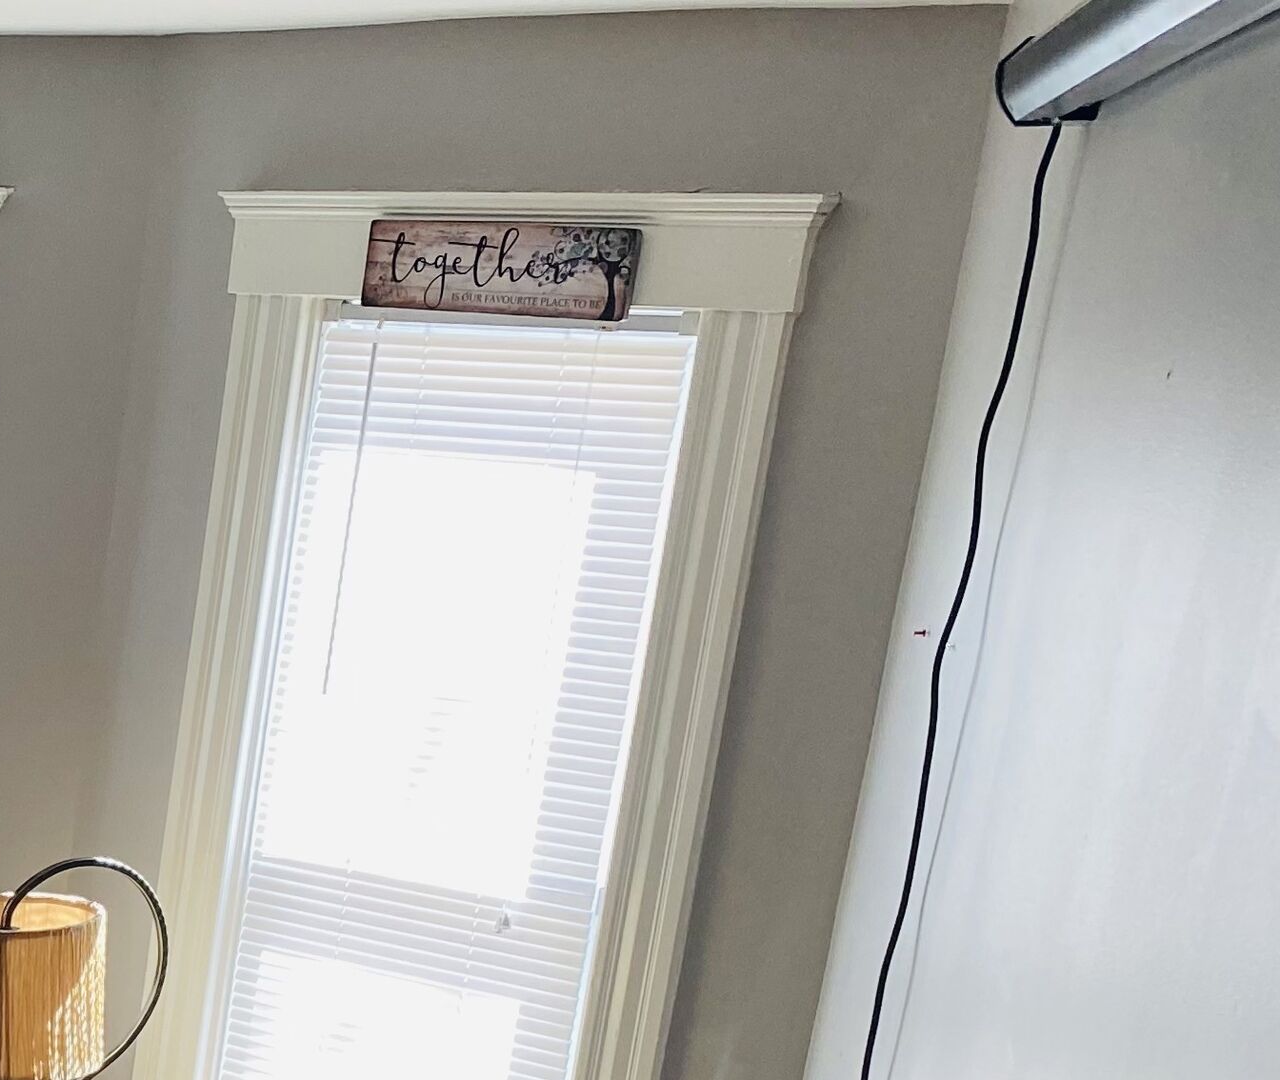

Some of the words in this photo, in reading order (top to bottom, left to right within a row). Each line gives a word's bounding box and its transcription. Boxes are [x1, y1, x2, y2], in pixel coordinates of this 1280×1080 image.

[371, 227, 574, 310] together
[451, 292, 459, 302] IS
[461, 292, 482, 303] OUR
[484, 294, 538, 306] FAVOURITE
[540, 296, 570, 308] PLACE
[573, 298, 587, 309] TO
[589, 299, 601, 310] BE
